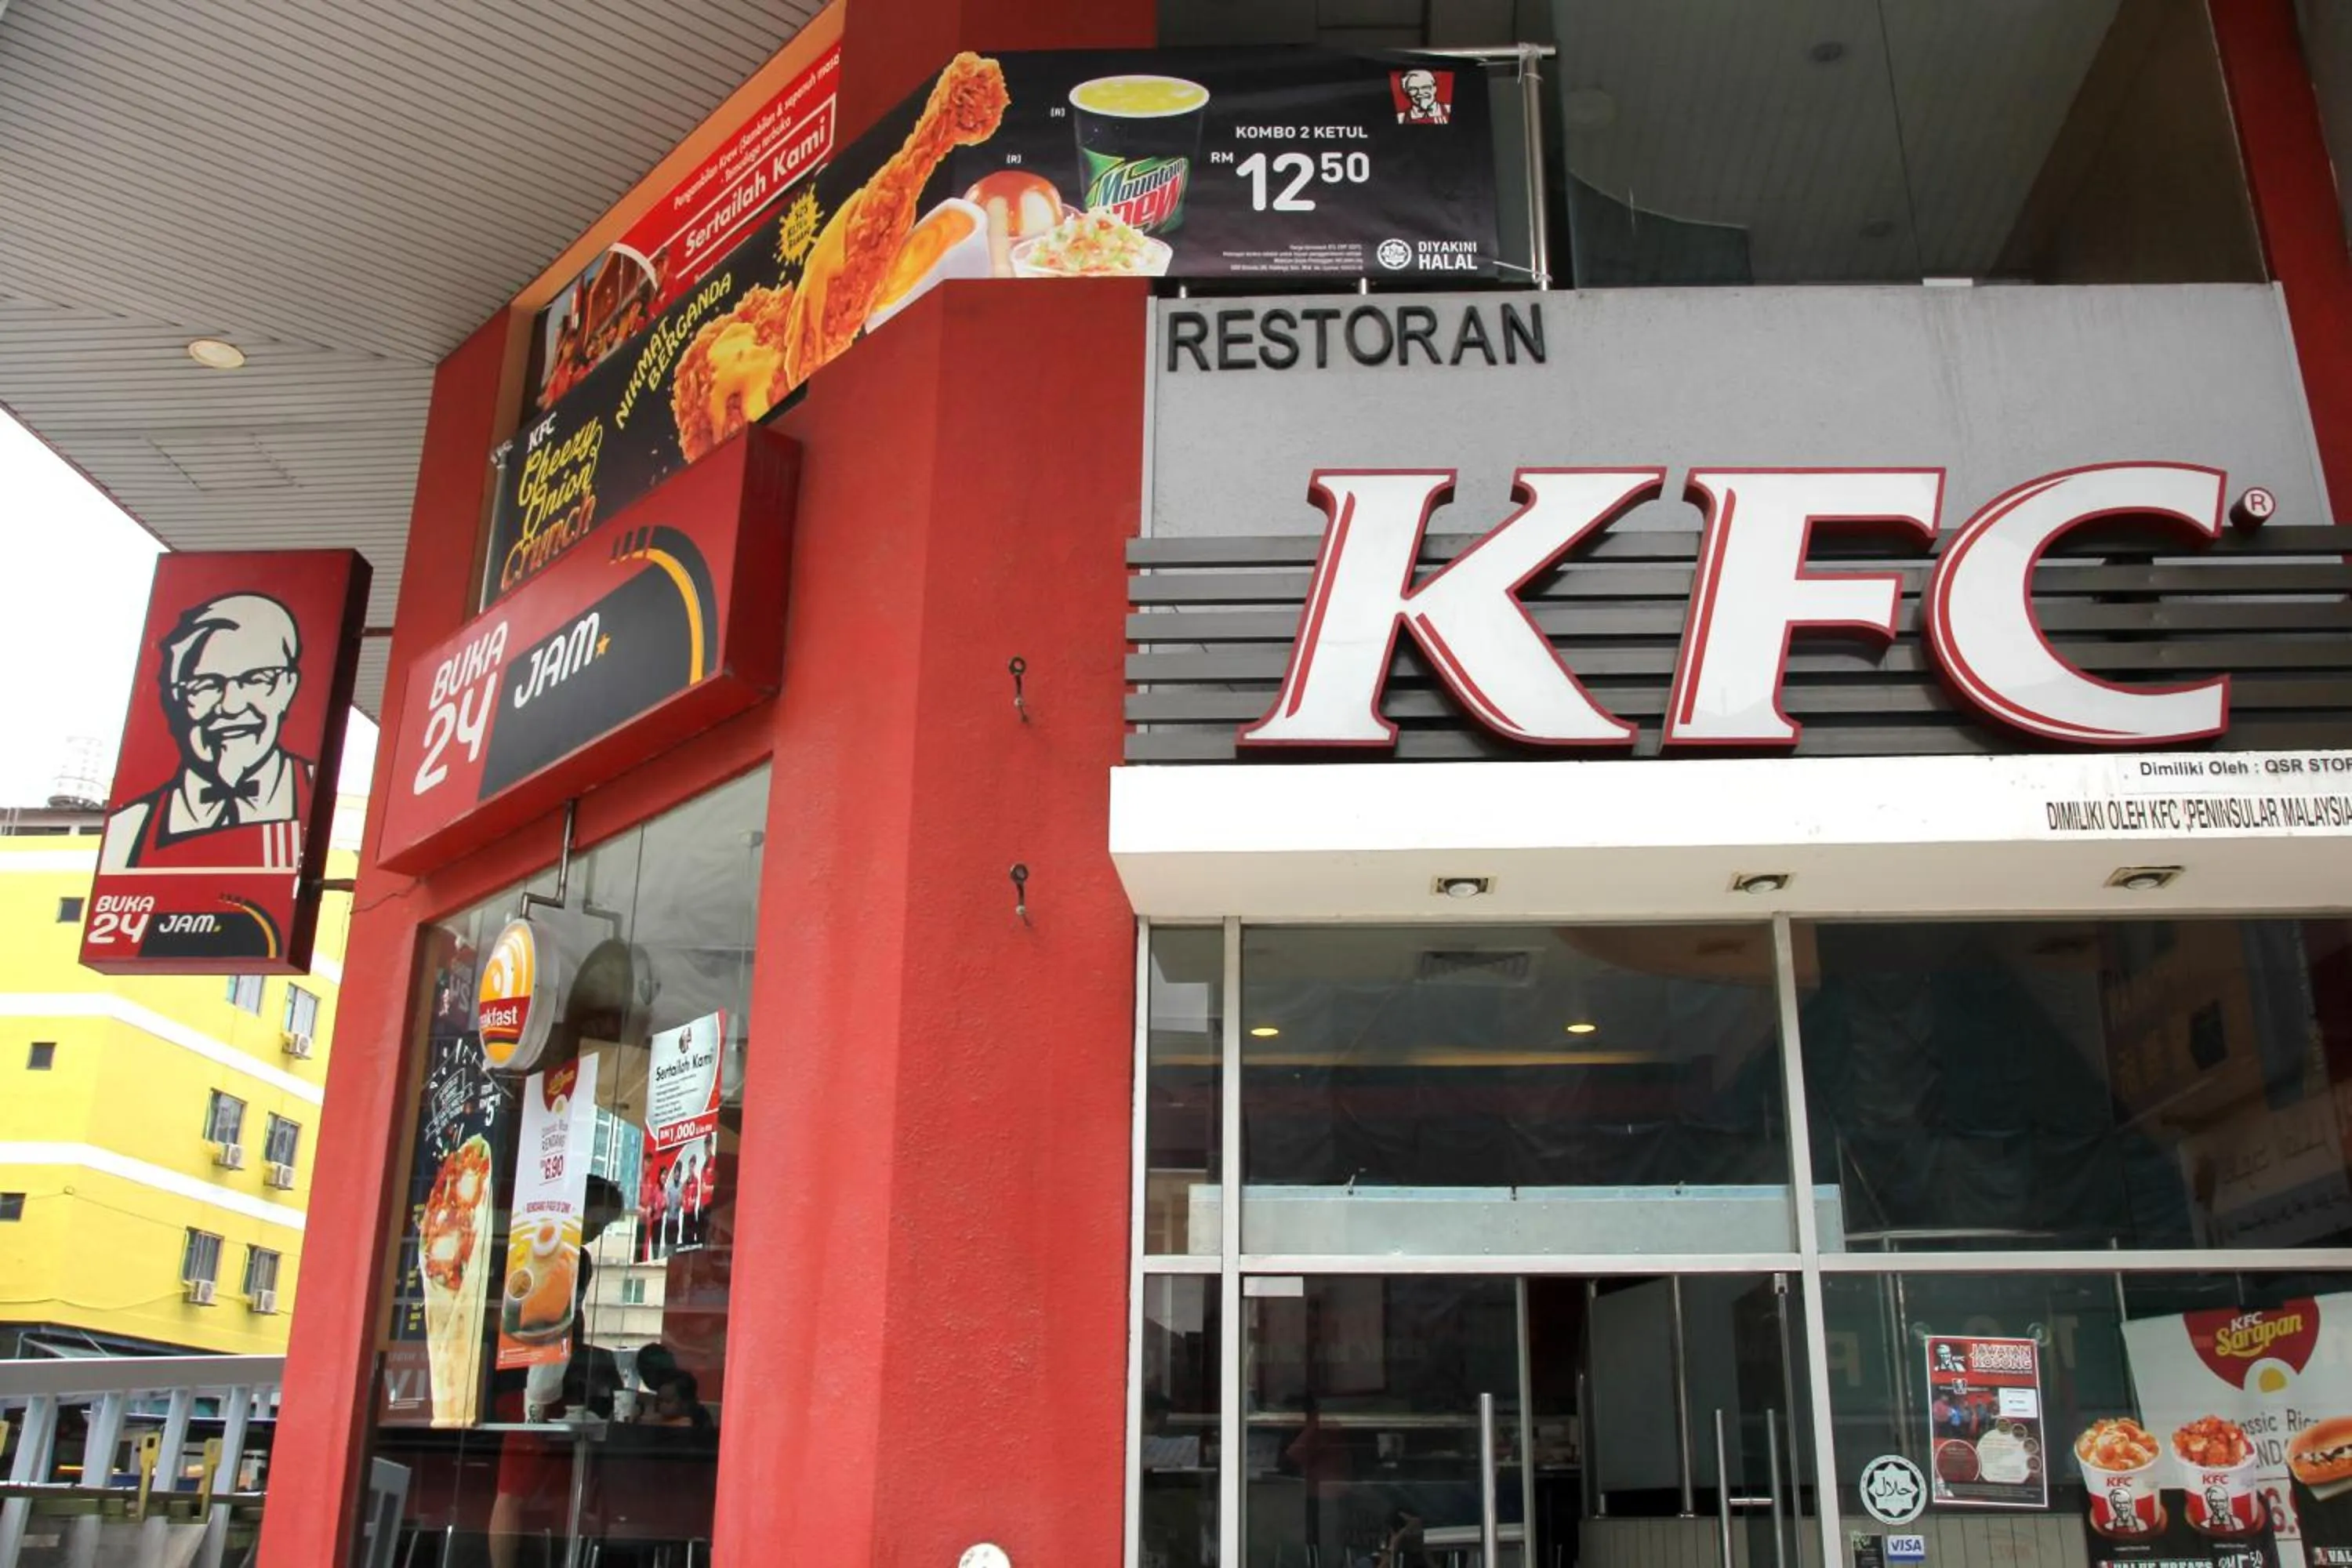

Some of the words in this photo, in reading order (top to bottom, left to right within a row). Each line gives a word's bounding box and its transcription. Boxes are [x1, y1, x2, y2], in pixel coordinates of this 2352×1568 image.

[1235, 125, 1298, 140] KOMBO
[1300, 125, 1310, 140] 2
[1314, 125, 1368, 140] KETUL
[684, 170, 767, 258] Sertailah
[772, 114, 826, 183] Kami
[1210, 151, 1234, 165] RM
[1234, 151, 1317, 212] 12
[1319, 151, 1371, 185] 50
[1417, 241, 1478, 253] DIYAKINI
[1417, 253, 1479, 270] HALAL
[647, 271, 732, 392] BERGANDA
[1166, 301, 1546, 373] RESTORAN
[615, 314, 673, 430] NIKMAT
[527, 411, 557, 453] KFC
[1236, 461, 2230, 750] KFC
[428, 620, 509, 711] BUKA
[413, 672, 499, 797] 24
[514, 612, 601, 709] JAM
[2140, 760, 2203, 776] Dimiliki
[2209, 760, 2249, 775] Oleh
[2264, 758, 2303, 774] QSR
[2046, 800, 2105, 831] DIMILIKI
[2108, 800, 2148, 829] OLEH
[2150, 799, 2181, 829] KFC
[95, 894, 155, 913] BUKA
[87, 913, 150, 945] 24
[158, 914, 214, 933] JAM
[2215, 1314, 2303, 1357] Sarapan
[2230, 1311, 2264, 1332] KFC
[1969, 1343, 2032, 1358] JAWATAN
[1972, 1356, 2033, 1370] KOSONG
[2285, 1408, 2319, 1432] Ric
[2106, 1476, 2133, 1487] KFC
[2201, 1474, 2230, 1485] KFC
[1891, 1539, 1922, 1552] VISA
